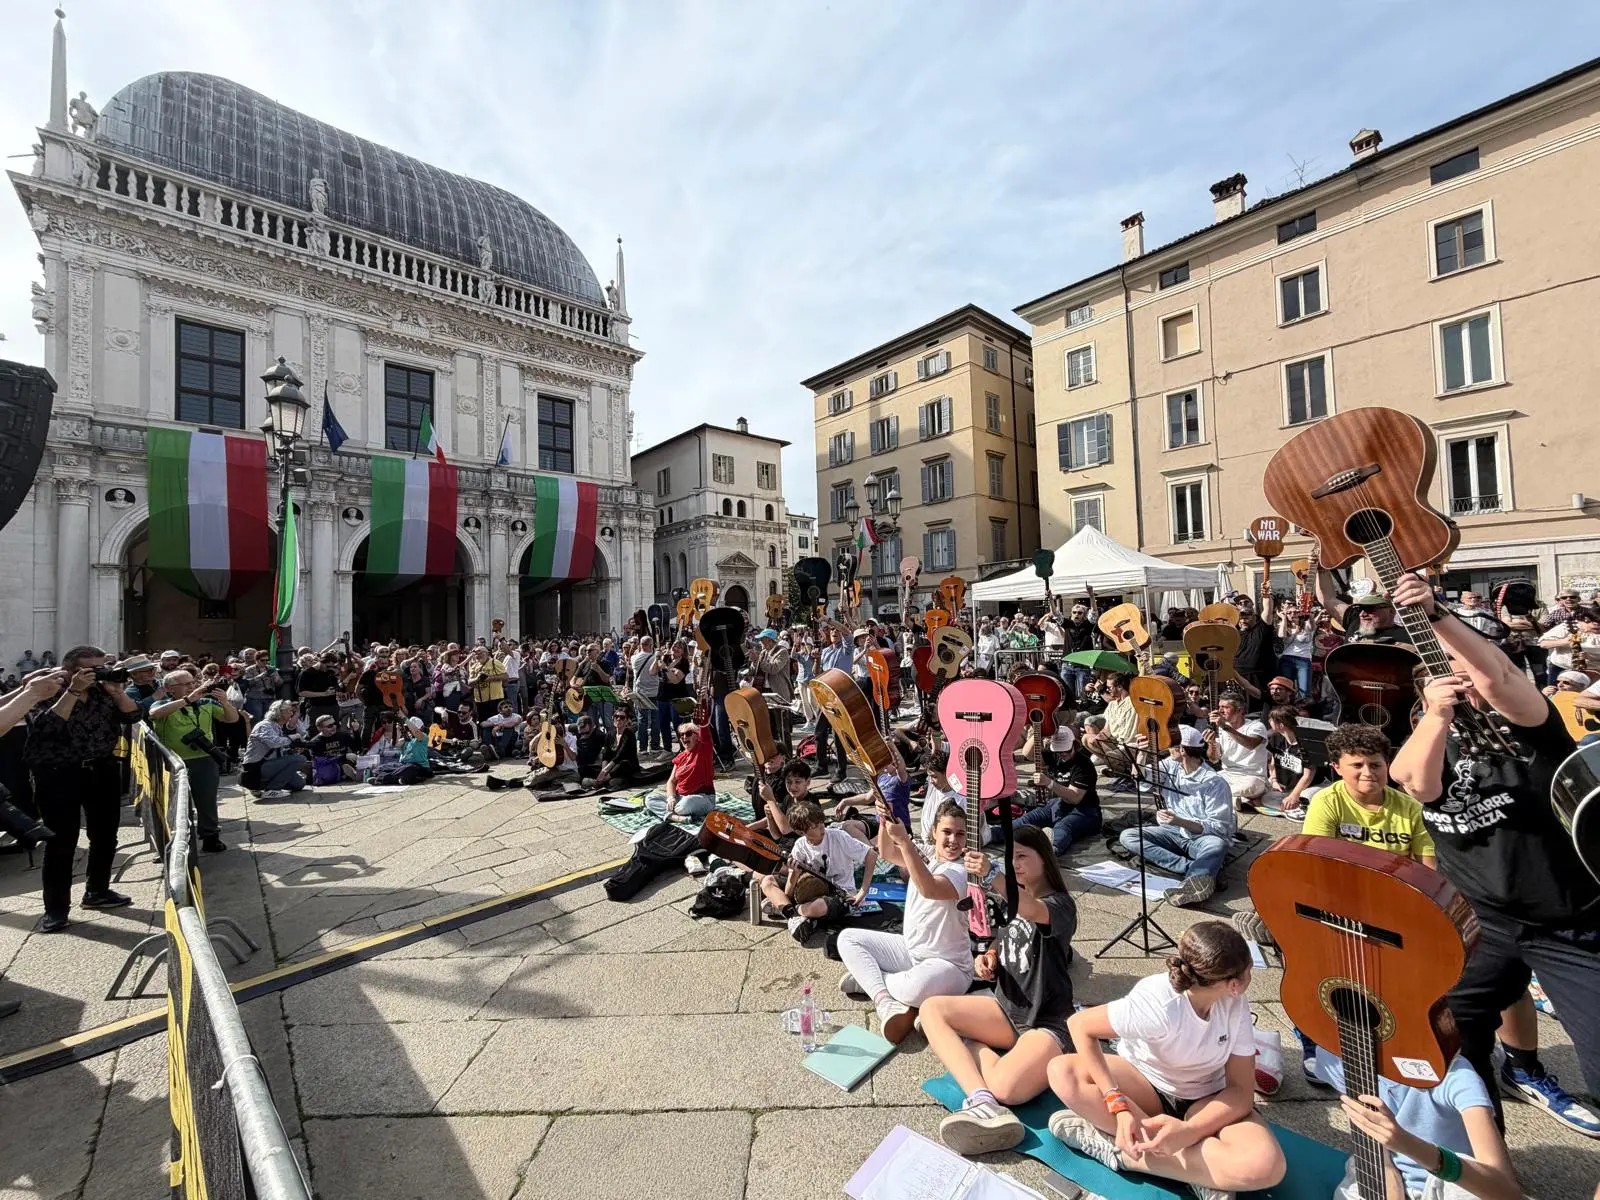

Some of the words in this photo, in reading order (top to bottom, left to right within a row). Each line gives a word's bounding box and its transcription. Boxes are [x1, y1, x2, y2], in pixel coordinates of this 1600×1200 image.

[1260, 519, 1276, 530] NO
[1257, 530, 1280, 541] WAR
[1422, 810, 1452, 824] 1000
[1456, 809, 1508, 834] PIAZZA
